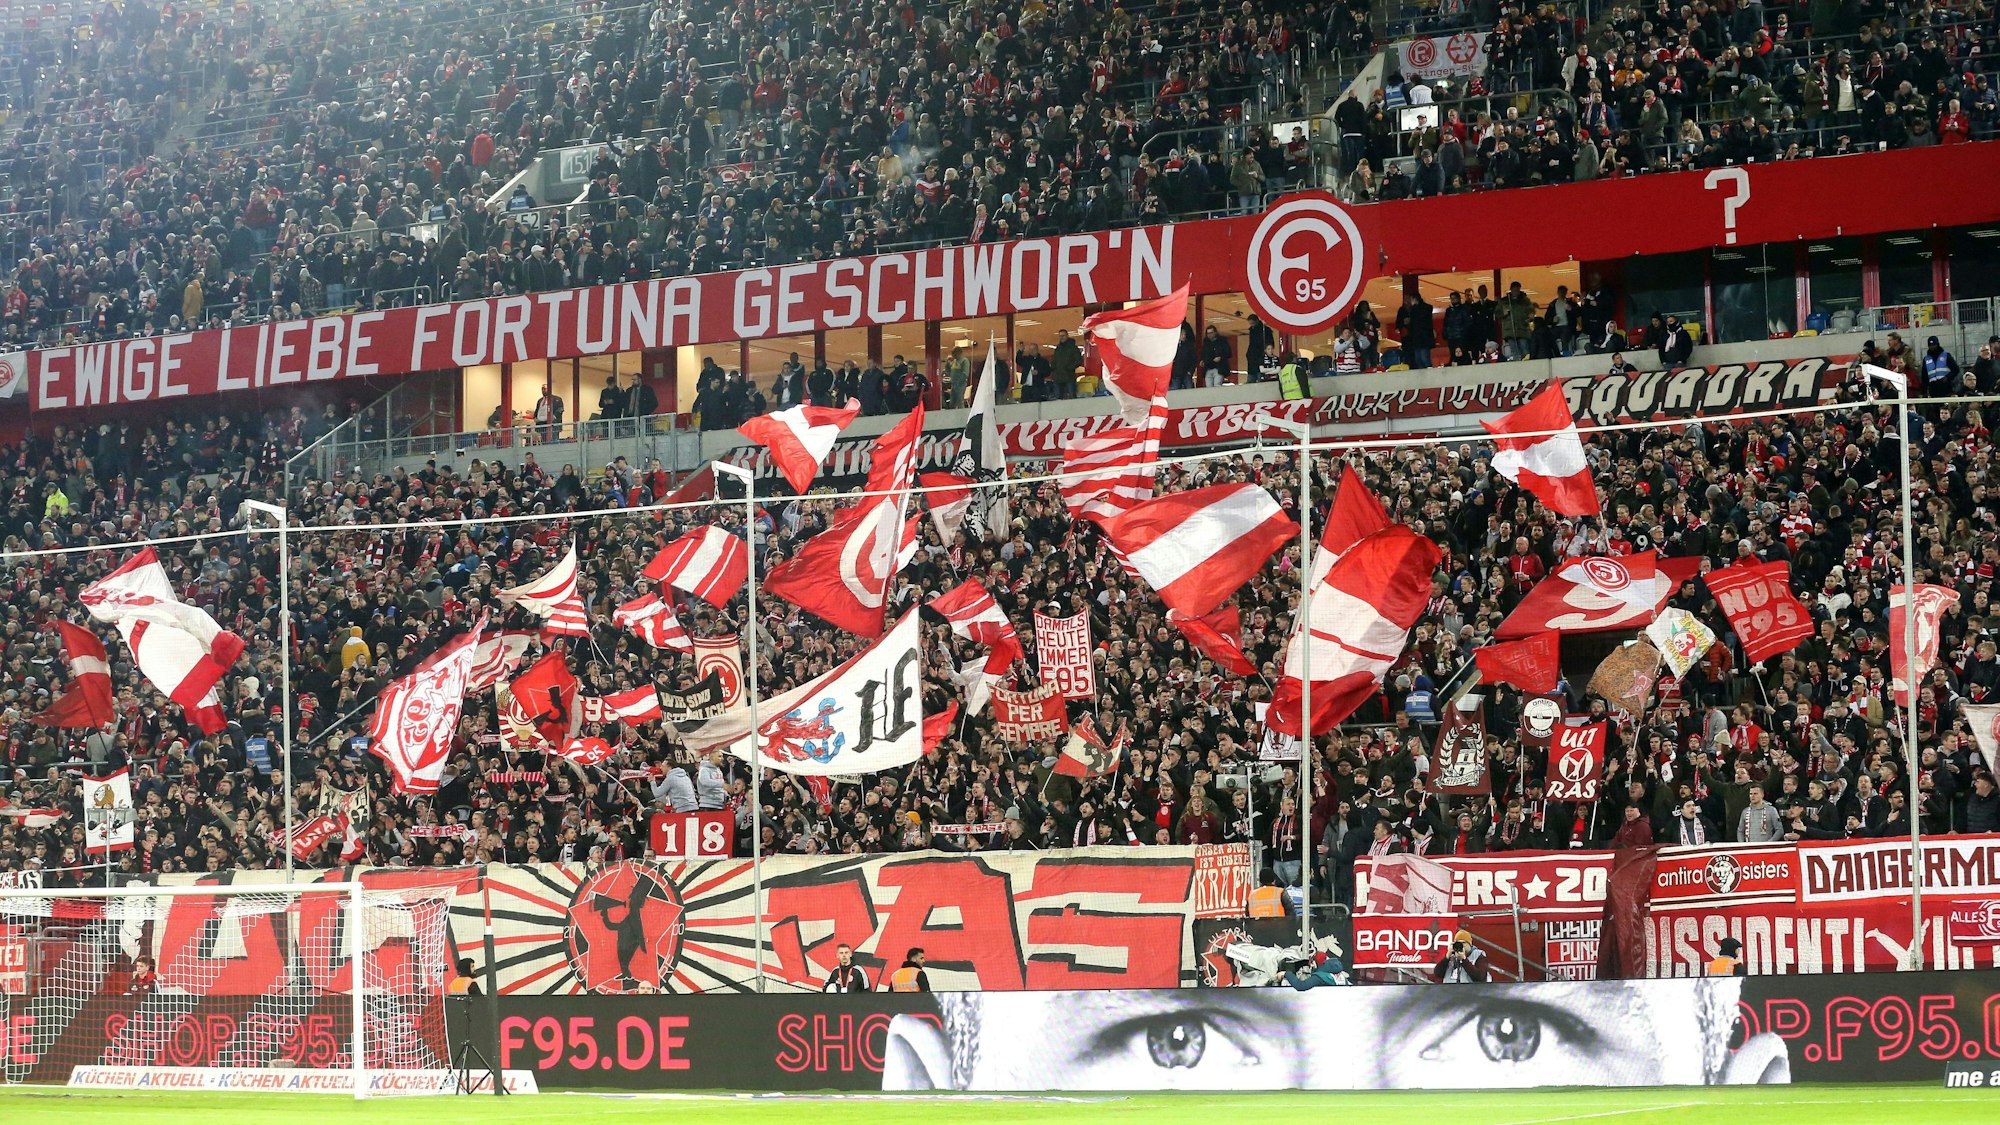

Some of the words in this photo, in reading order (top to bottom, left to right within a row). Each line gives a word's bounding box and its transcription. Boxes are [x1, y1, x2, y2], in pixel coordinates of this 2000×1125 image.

[1406, 64, 1480, 80] Rtingen-Sü
[1703, 167, 1751, 245] ?
[520, 211, 540, 230] 52
[1295, 277, 1326, 302] 95
[38, 330, 193, 410] EWIGE
[216, 311, 386, 391] LIEBE
[410, 275, 701, 372] FORTUNA
[732, 225, 1174, 339] GESCHWOR'N
[1563, 358, 1826, 426] SQUADRA
[1178, 398, 1312, 439] WEST
[1719, 579, 1790, 617] NUR
[1036, 614, 1085, 631] DAMALS
[1734, 602, 1797, 641] F95
[1037, 628, 1086, 647] HEUTE
[1039, 646, 1088, 666] IMMER
[1040, 665, 1089, 694] F95
[661, 692, 686, 709] WIR
[686, 688, 711, 708] SIND
[989, 679, 1061, 704] FORTUNA
[1007, 703, 1043, 722] PER
[1532, 699, 1553, 708] antira
[998, 718, 1064, 742] SEMPRE
[586, 743, 606, 762] 95
[1546, 779, 1597, 799] RAS
[292, 819, 337, 855] TUNA
[1200, 856, 1215, 868] IST
[1657, 867, 1703, 887] antira
[1742, 861, 1789, 881] sisters
[1195, 865, 1251, 911] KRAFT
[1951, 911, 1987, 924] ALLES
[1356, 929, 1454, 951] BANDA
[1549, 920, 1602, 939] CASUA
[1730, 994, 2000, 1063] P.F95.
[501, 1015, 690, 1071] F95.DE
[775, 1013, 942, 1072] SHO
[74, 1069, 136, 1085] KÜCHEN
[138, 1071, 205, 1087] AKTUELL
[218, 1070, 285, 1088] KÜCHEN
[369, 1073, 440, 1090] KÜCHEN
[1947, 1069, 1984, 1088] me
